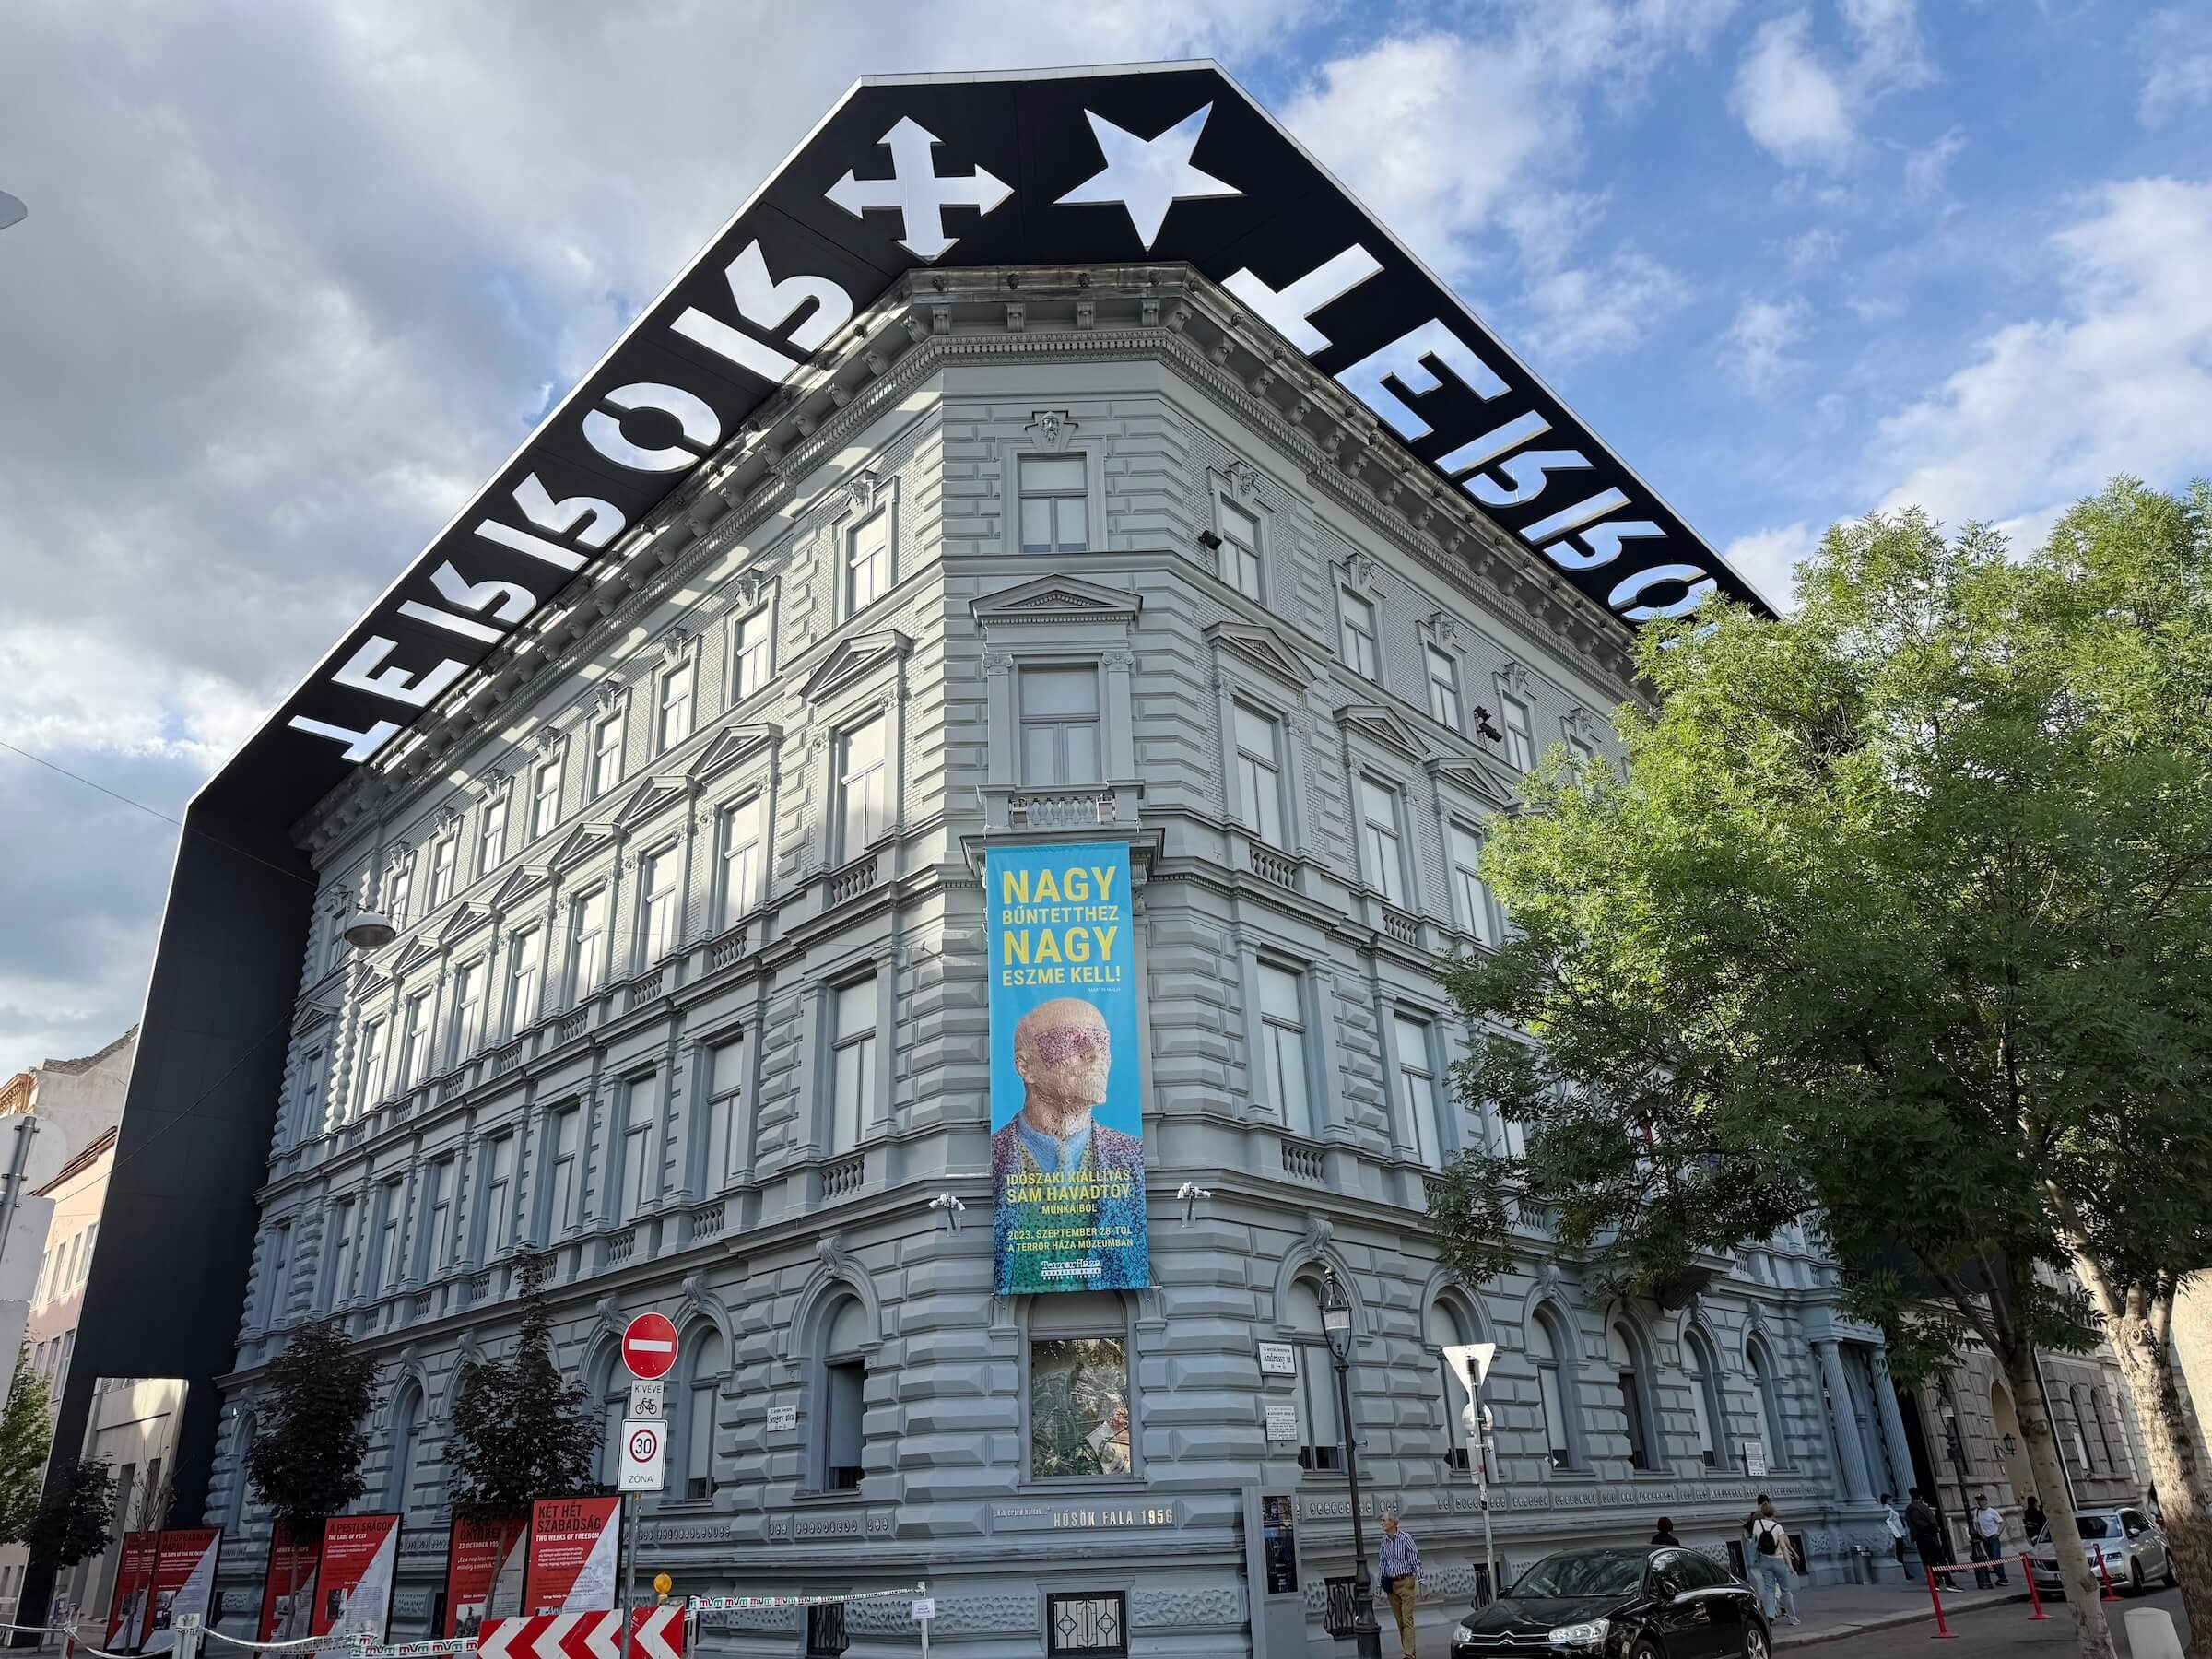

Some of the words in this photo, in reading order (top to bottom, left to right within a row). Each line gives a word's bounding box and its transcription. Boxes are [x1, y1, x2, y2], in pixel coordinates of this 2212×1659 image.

[1003, 866, 1116, 905] NAGY
[1003, 905, 1119, 925] BŰNTETTHEZ
[1004, 925, 1118, 966] NAGY
[1003, 968, 1065, 986] ESZME
[1071, 966, 1121, 983] KELL!
[1006, 1172, 1064, 1186] IDŐSZAKI
[1006, 1186, 1041, 1203] SAM
[1046, 1183, 1131, 1201] HAVADTOY
[1041, 1203, 1098, 1215] MUNKÁIBÓL
[1007, 1230, 1032, 1240] 2023.
[1036, 1228, 1098, 1239] SZEPTEMBER
[1100, 1224, 1133, 1236] 28-TÓL
[1007, 1244, 1015, 1253] A
[1016, 1241, 1050, 1252] TERROR
[1052, 1240, 1077, 1250] HÁZA
[1078, 1238, 1134, 1249] MÚZEUMBAN
[635, 1438, 652, 1454] 30
[538, 1503, 559, 1519] KÉT
[562, 1502, 582, 1518] HÉT
[1053, 1506, 1095, 1527] HŐSÖK
[1102, 1511, 1134, 1525] FALA
[1140, 1509, 1173, 1524] 1956
[537, 1515, 602, 1533] SZABADSÁG
[574, 1532, 599, 1540] FREEDOM
